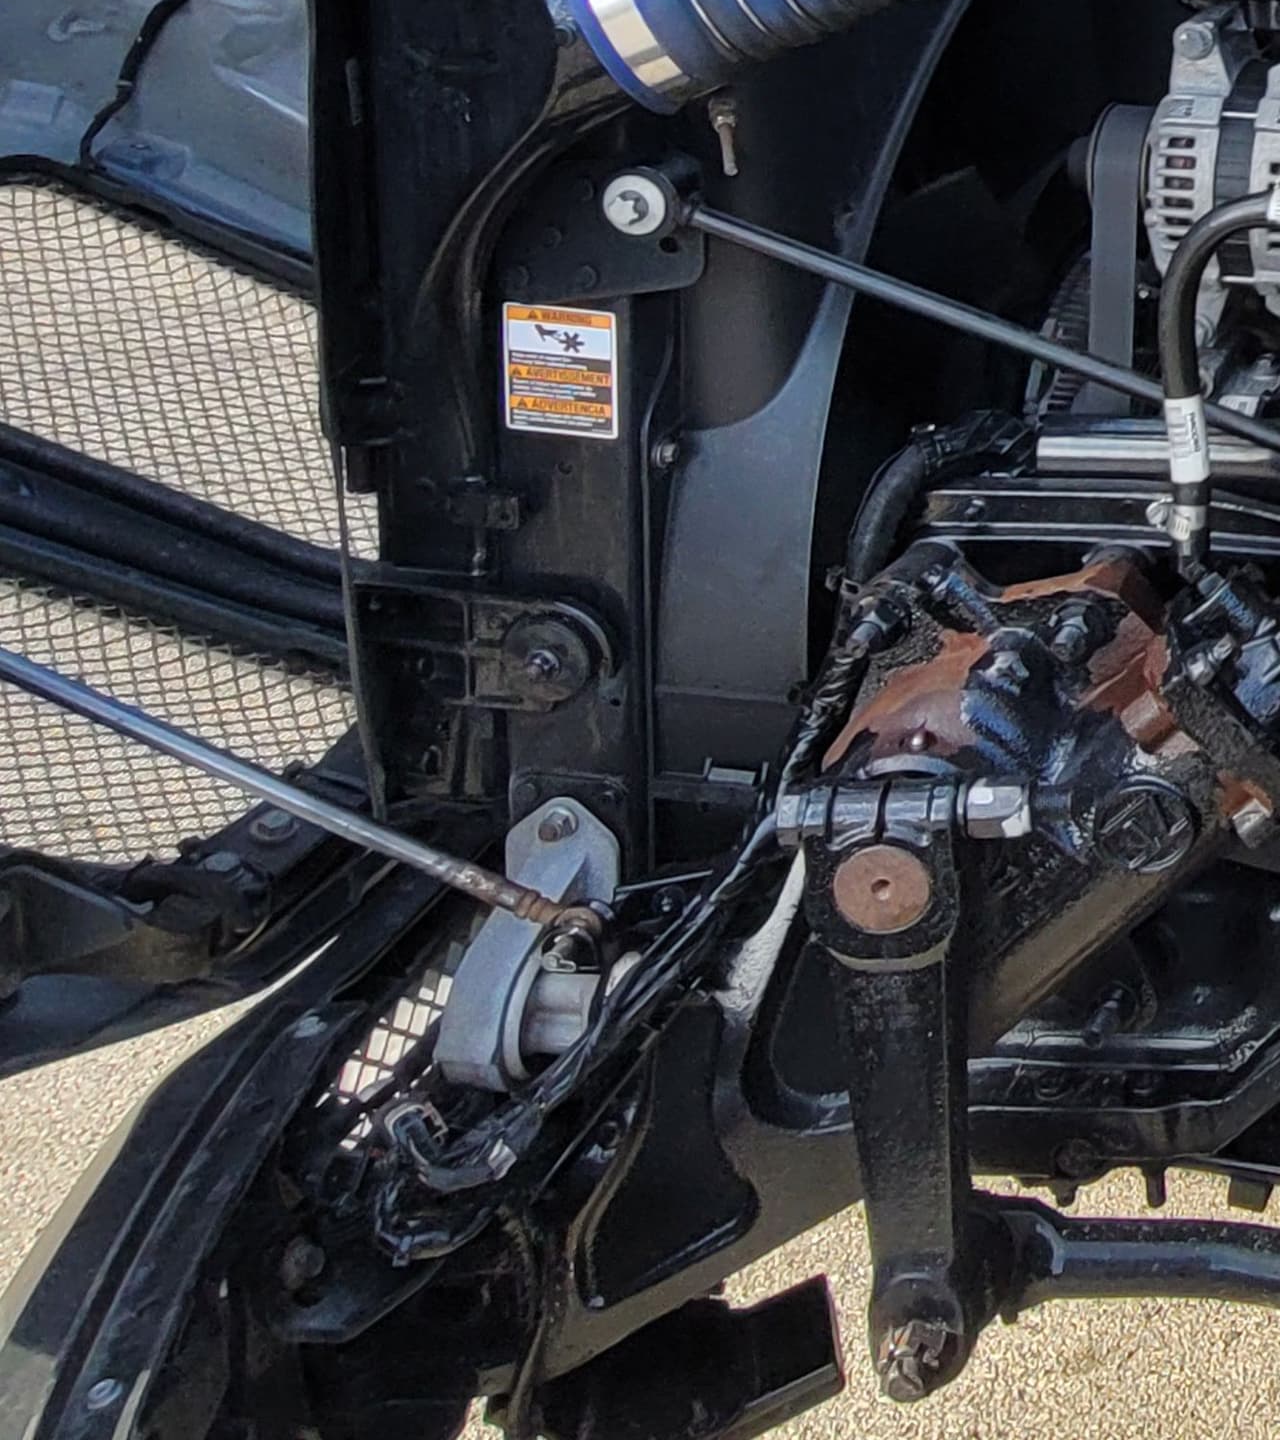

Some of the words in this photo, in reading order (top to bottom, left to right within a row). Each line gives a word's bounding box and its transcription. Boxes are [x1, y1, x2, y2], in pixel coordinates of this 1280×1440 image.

[542, 309, 592, 325] WARNING
[526, 367, 610, 384] AVERTISSEMENT
[531, 397, 606, 415] ADVERTENCIA
